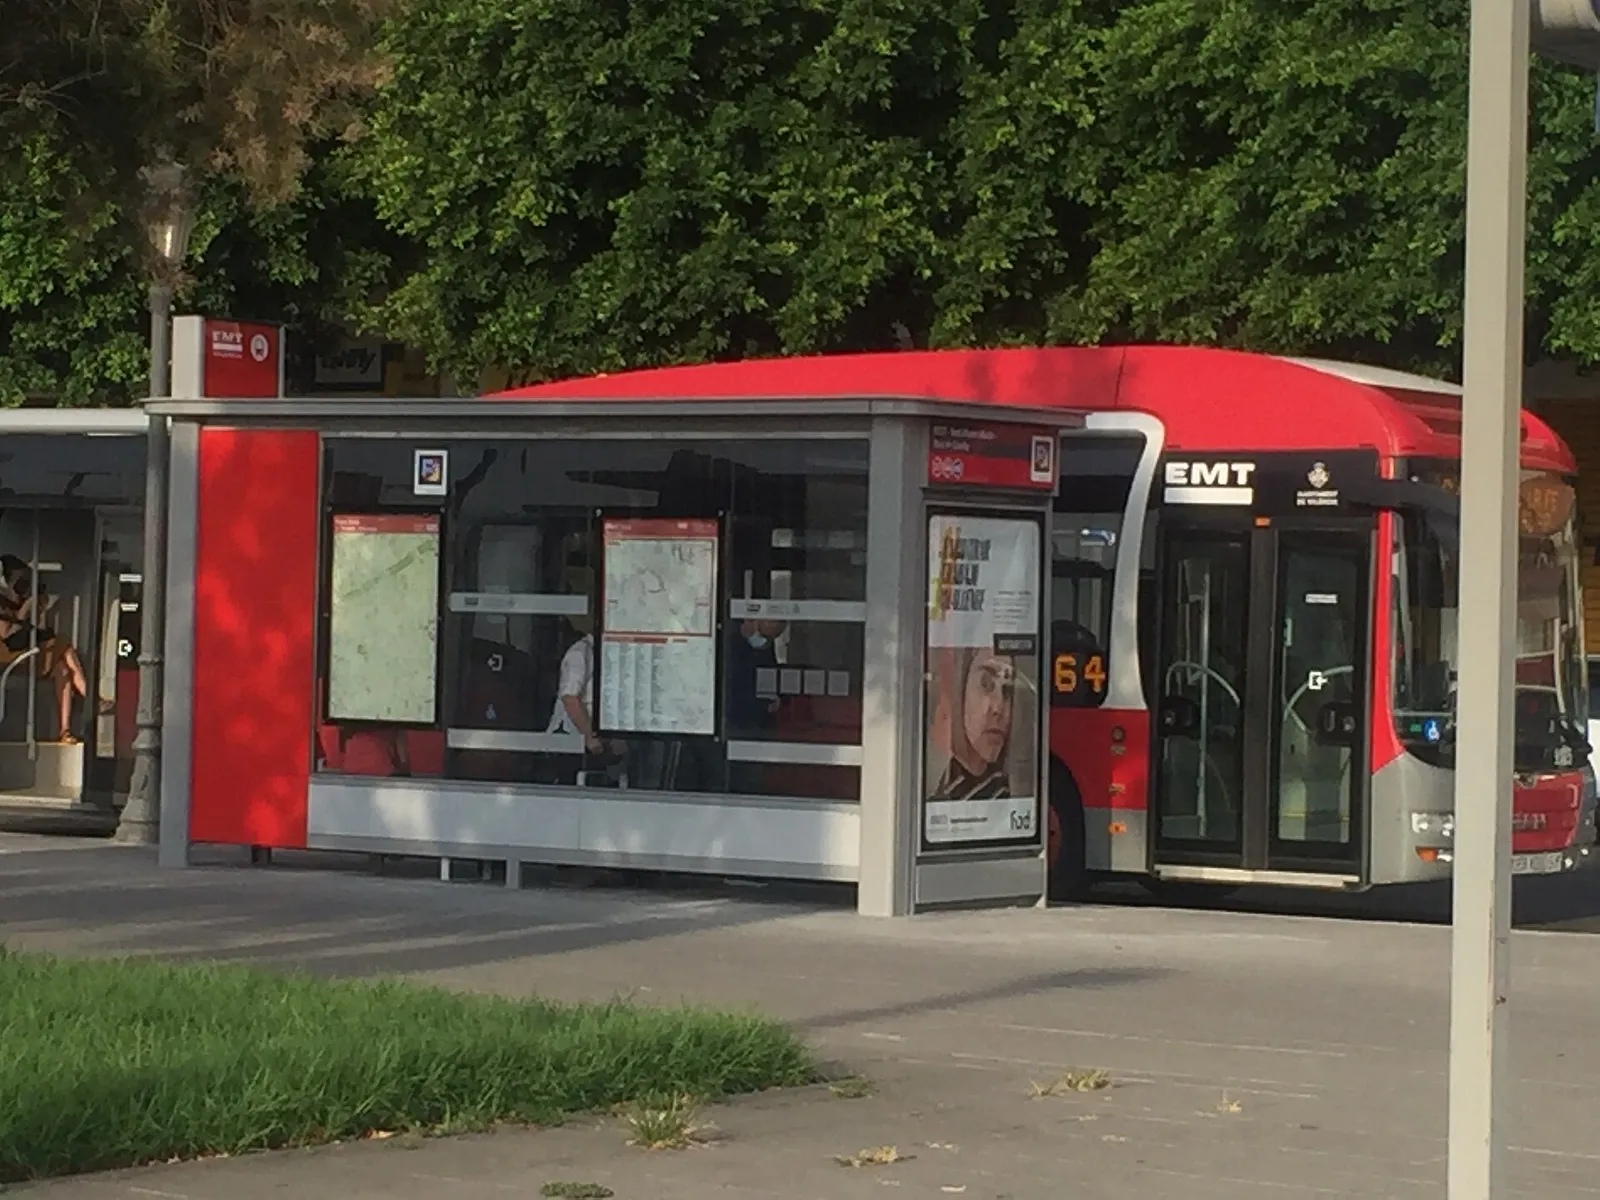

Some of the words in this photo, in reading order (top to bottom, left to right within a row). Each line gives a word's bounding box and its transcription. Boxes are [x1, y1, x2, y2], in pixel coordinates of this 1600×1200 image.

[211, 330, 243, 343] EMT
[1164, 462, 1256, 486] EMT
[1055, 653, 1106, 693] 64
